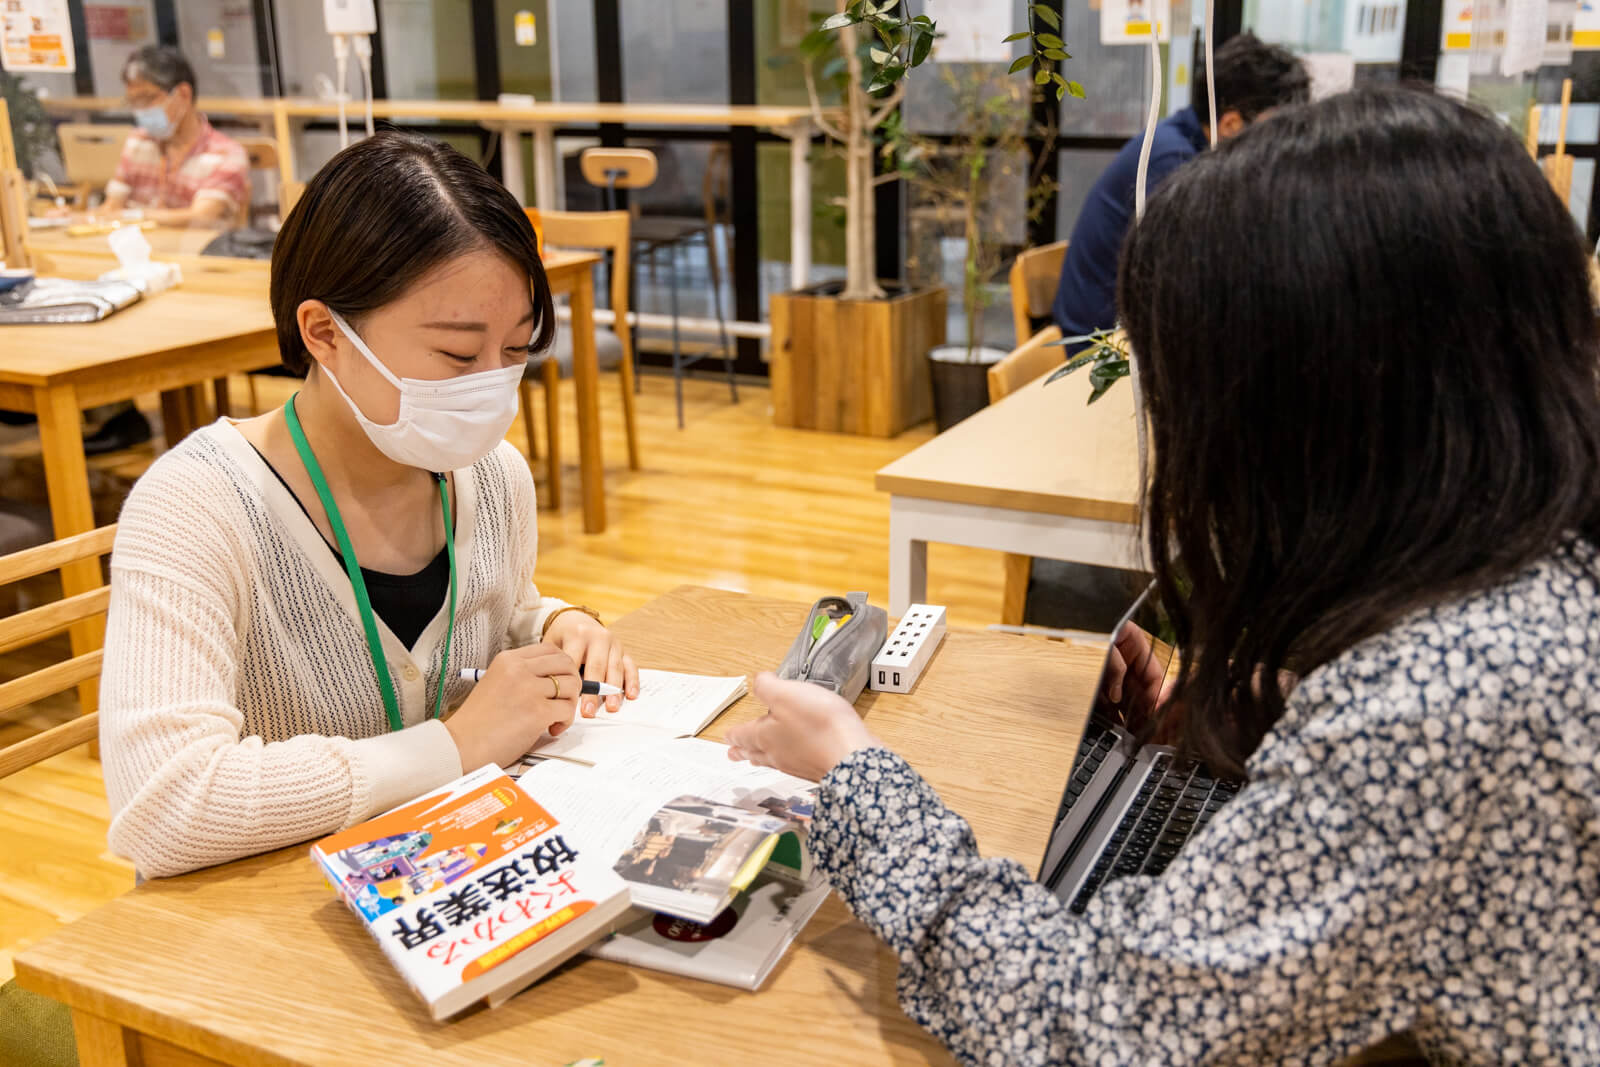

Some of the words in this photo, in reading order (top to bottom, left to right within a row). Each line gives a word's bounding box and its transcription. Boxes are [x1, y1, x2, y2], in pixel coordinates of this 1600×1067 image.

[392, 834, 579, 950] 放送業界
[426, 869, 579, 965] よくわかる
